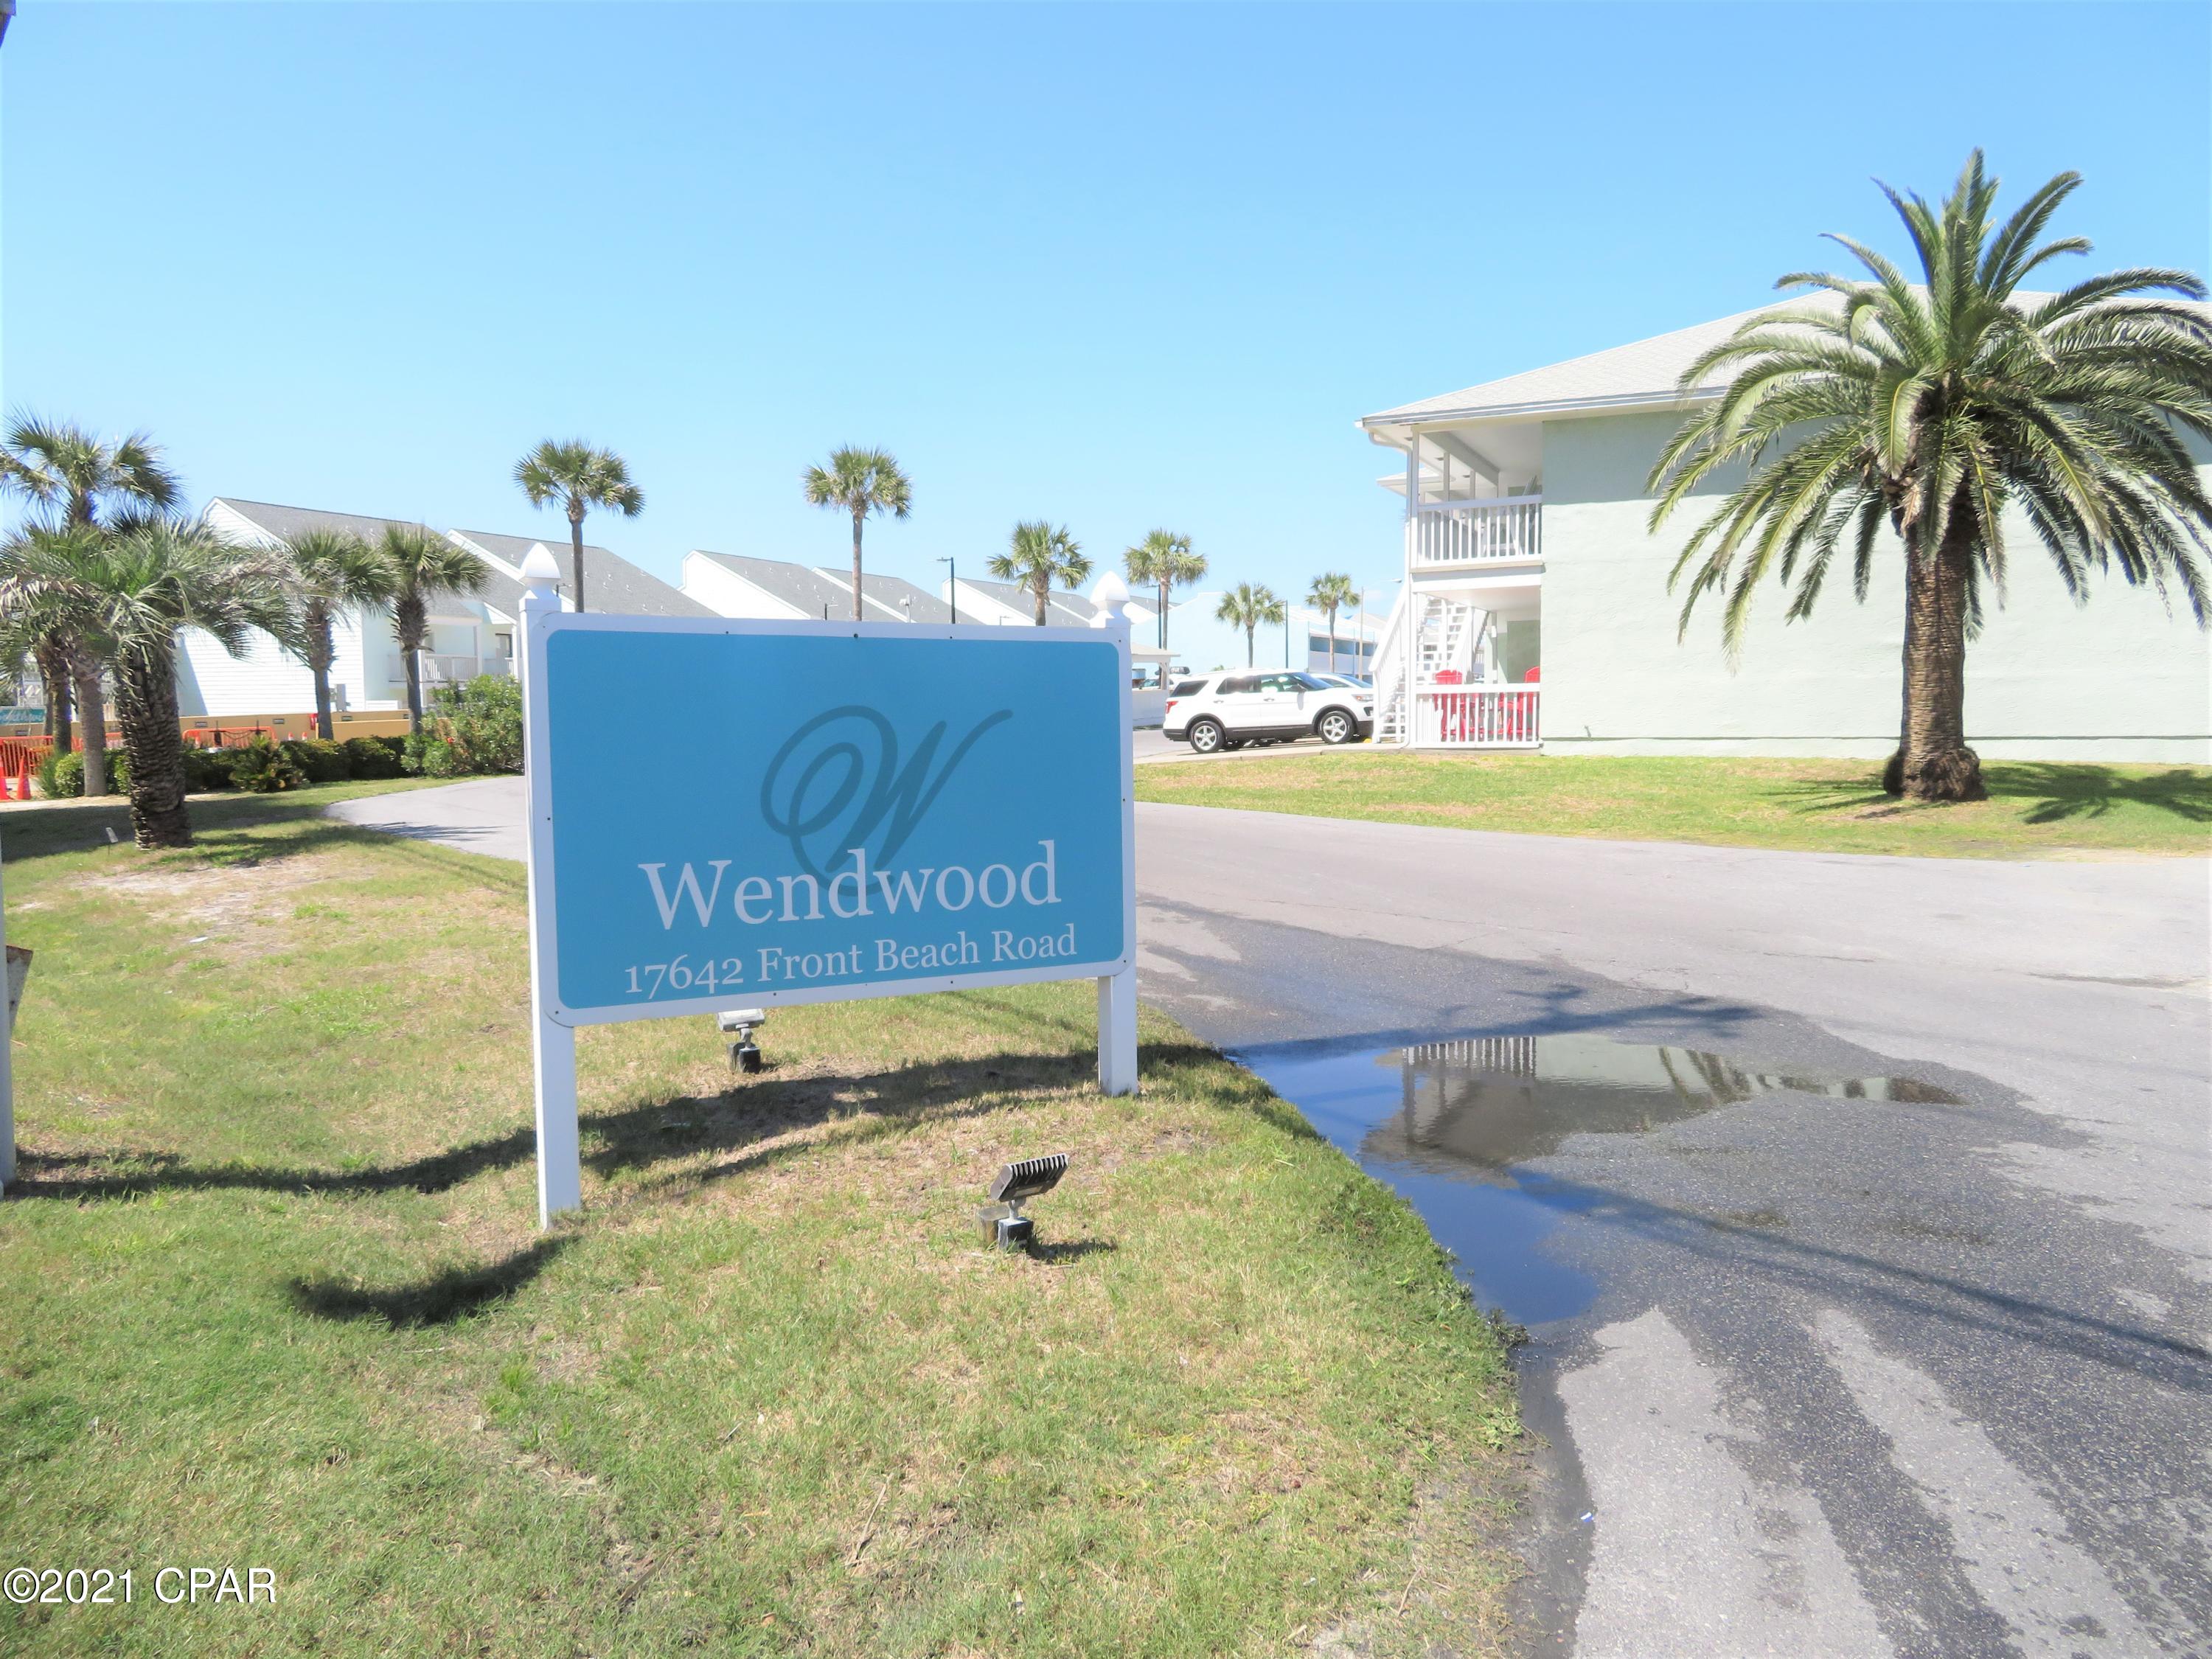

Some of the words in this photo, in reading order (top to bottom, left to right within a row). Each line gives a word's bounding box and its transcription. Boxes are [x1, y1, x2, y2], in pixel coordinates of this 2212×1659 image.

[638, 839, 1062, 931] Wendwood
[625, 954, 745, 999] 17642
[757, 944, 863, 981] Front
[874, 931, 980, 972] Beach
[991, 922, 1077, 961] Road
